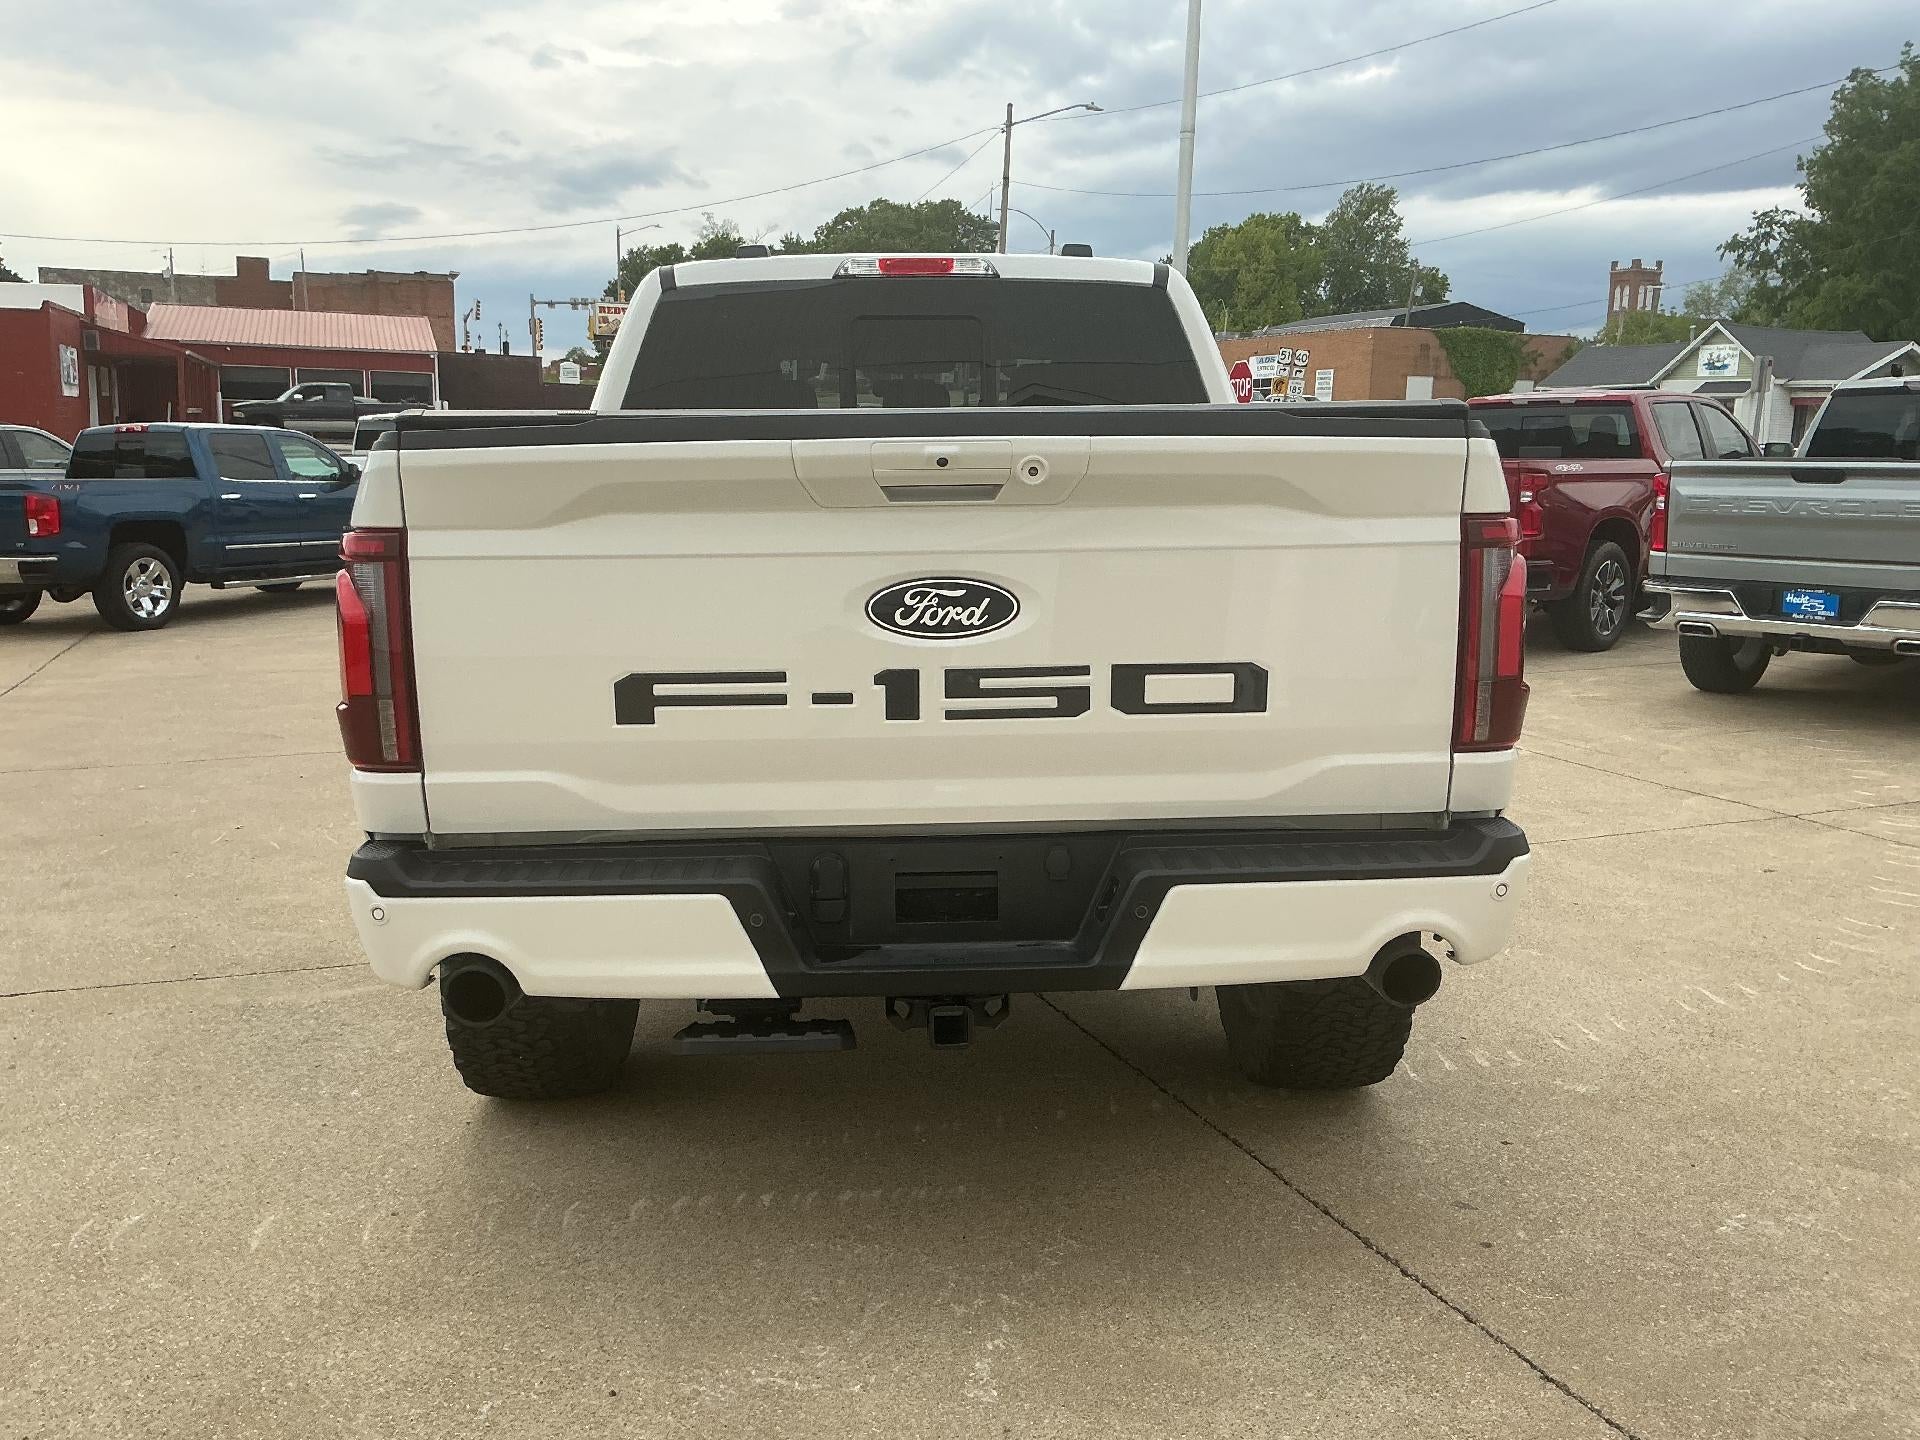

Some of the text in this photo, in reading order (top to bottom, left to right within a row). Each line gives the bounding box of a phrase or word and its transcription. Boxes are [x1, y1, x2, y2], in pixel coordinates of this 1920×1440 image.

[1280, 350, 1291, 361] 51
[1296, 353, 1308, 363] 40
[1289, 385, 1302, 394] 185
[894, 587, 991, 626] Ford
[614, 662, 1269, 725] F-150
